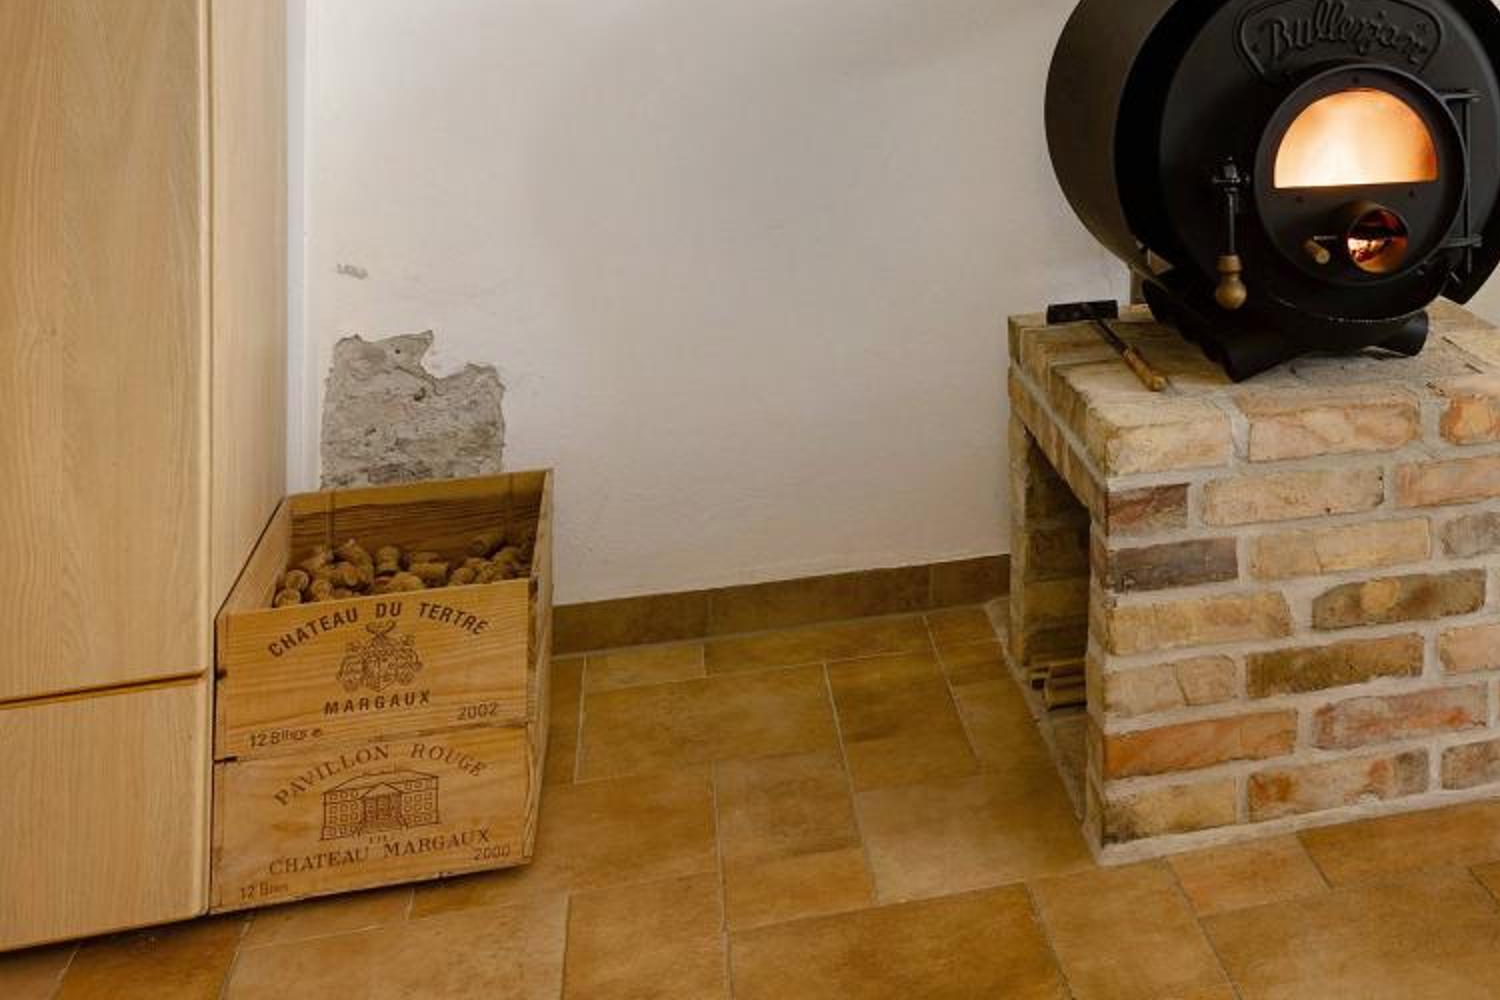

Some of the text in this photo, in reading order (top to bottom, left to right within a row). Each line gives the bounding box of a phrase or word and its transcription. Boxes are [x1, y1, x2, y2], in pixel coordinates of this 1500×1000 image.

[268, 602, 488, 657] CHATEAU DU TERTRE
[324, 689, 431, 715] MARGAUX
[456, 701, 499, 720] 2002
[273, 743, 487, 806] PAVILLON ROUGE
[268, 827, 490, 875] CHATEAU MARGAUX
